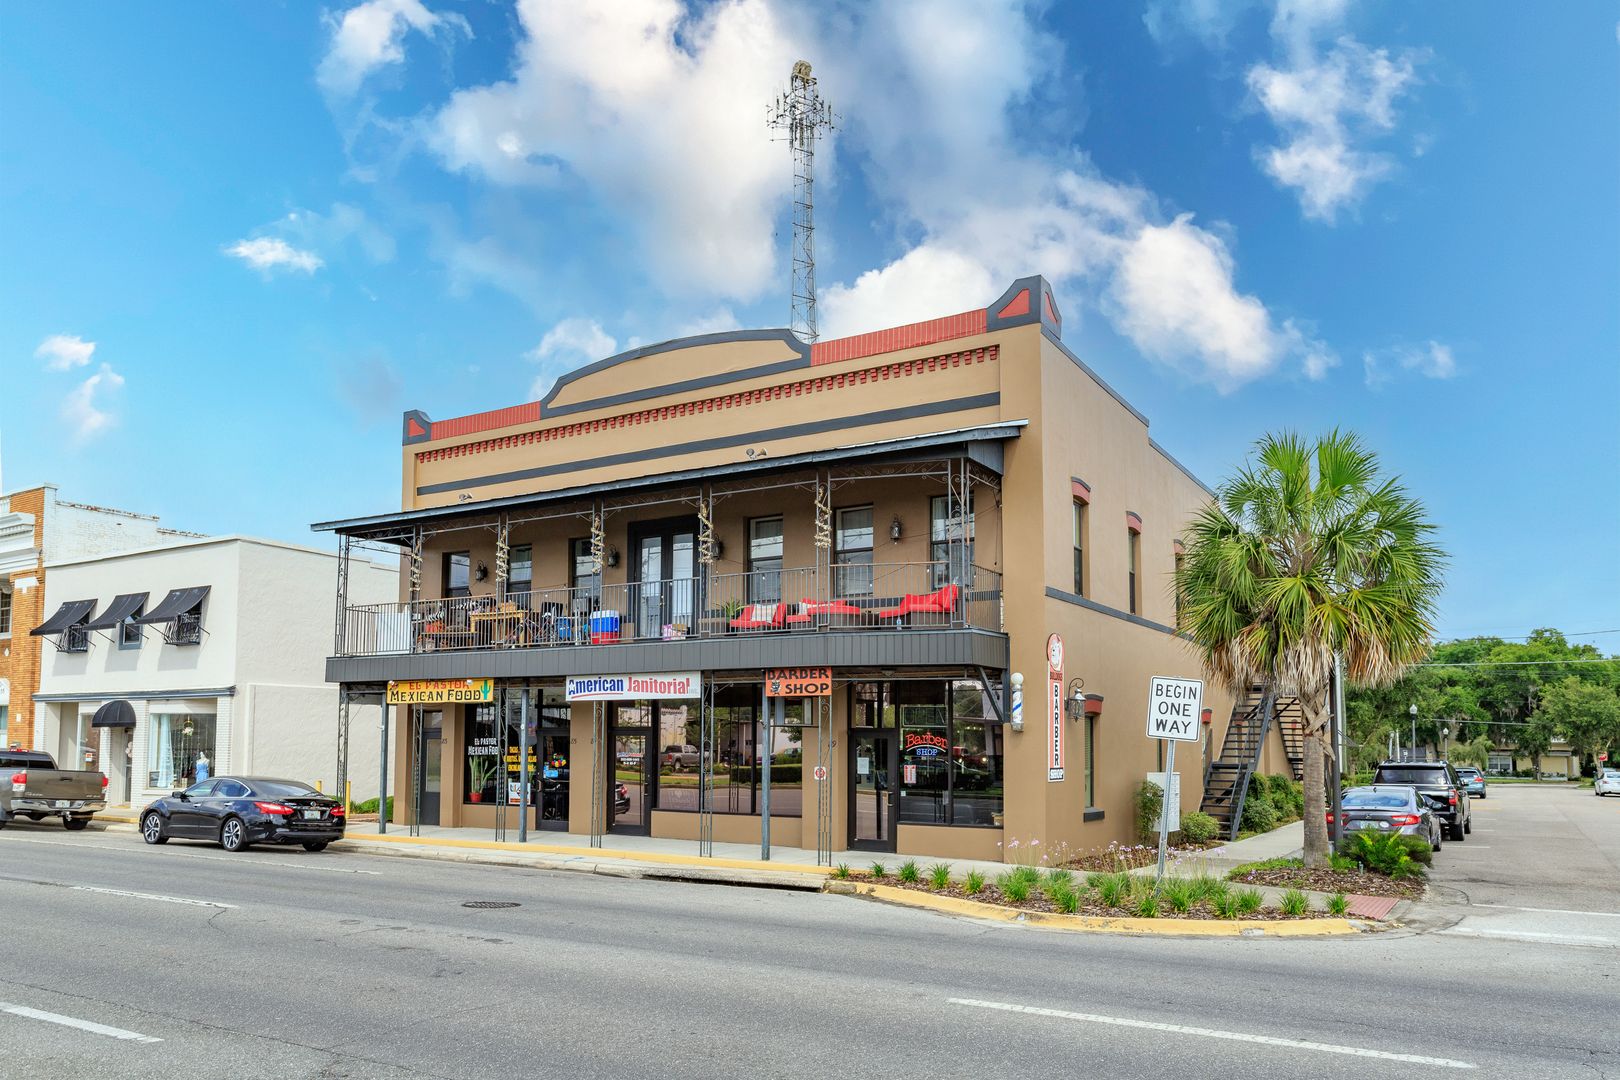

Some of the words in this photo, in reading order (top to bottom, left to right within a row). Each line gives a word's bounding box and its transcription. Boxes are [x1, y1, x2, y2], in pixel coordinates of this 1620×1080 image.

[767, 667, 829, 680] BARBER
[409, 681, 421, 690] EL
[425, 680, 469, 690] PASTOR
[568, 676, 624, 695] American
[627, 676, 690, 694] Janitorial
[785, 682, 830, 694] SHOP
[1155, 683, 1197, 700] BEGIN
[390, 690, 444, 702] MEXICAN
[447, 689, 481, 701] FOOD
[1158, 701, 1192, 717] ONE
[1155, 718, 1192, 734] WAY
[480, 737, 498, 746] PASTOR
[905, 731, 948, 749] Barber
[467, 745, 489, 756] MEXICAN
[489, 745, 500, 756] FOO
[916, 748, 938, 756] SHOP
